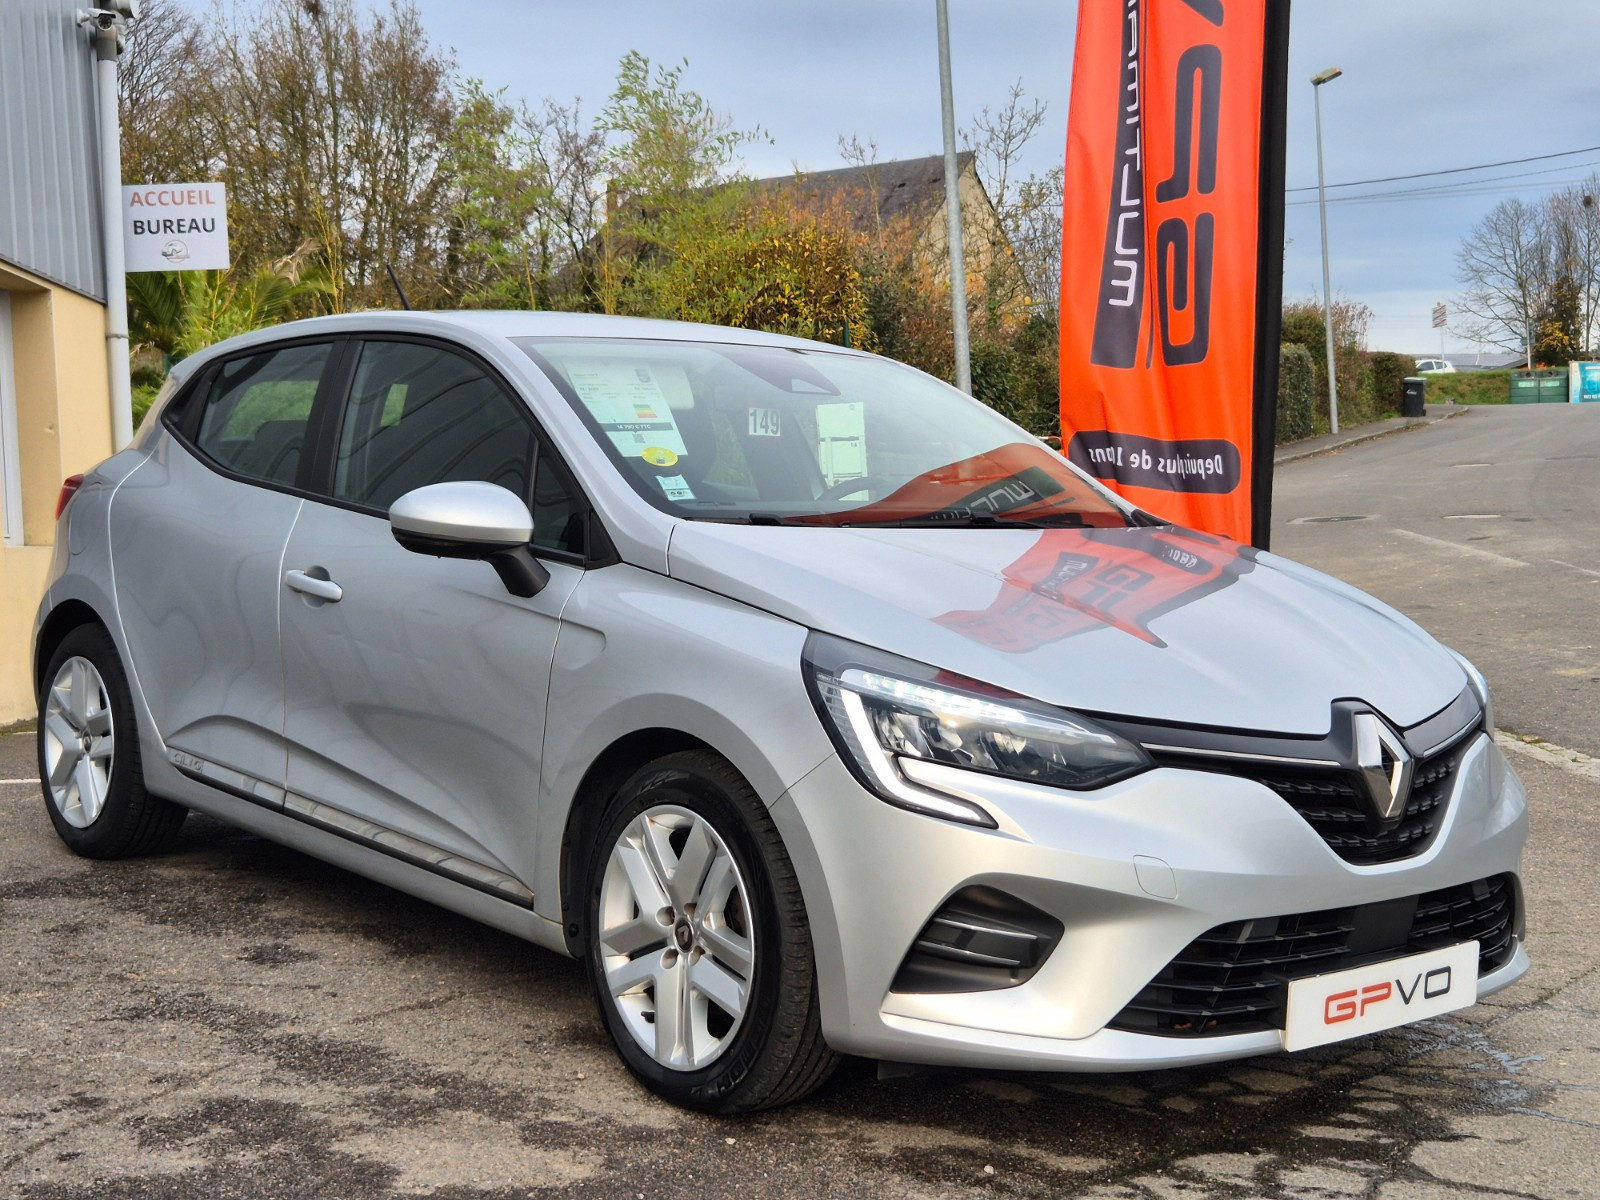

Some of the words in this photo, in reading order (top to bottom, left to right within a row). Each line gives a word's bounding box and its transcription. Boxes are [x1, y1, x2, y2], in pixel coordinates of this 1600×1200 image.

[130, 189, 216, 208] ACCUEIL
[133, 217, 217, 236] BUREAU
[750, 408, 780, 435] 149
[1323, 965, 1452, 1025] GPVO
